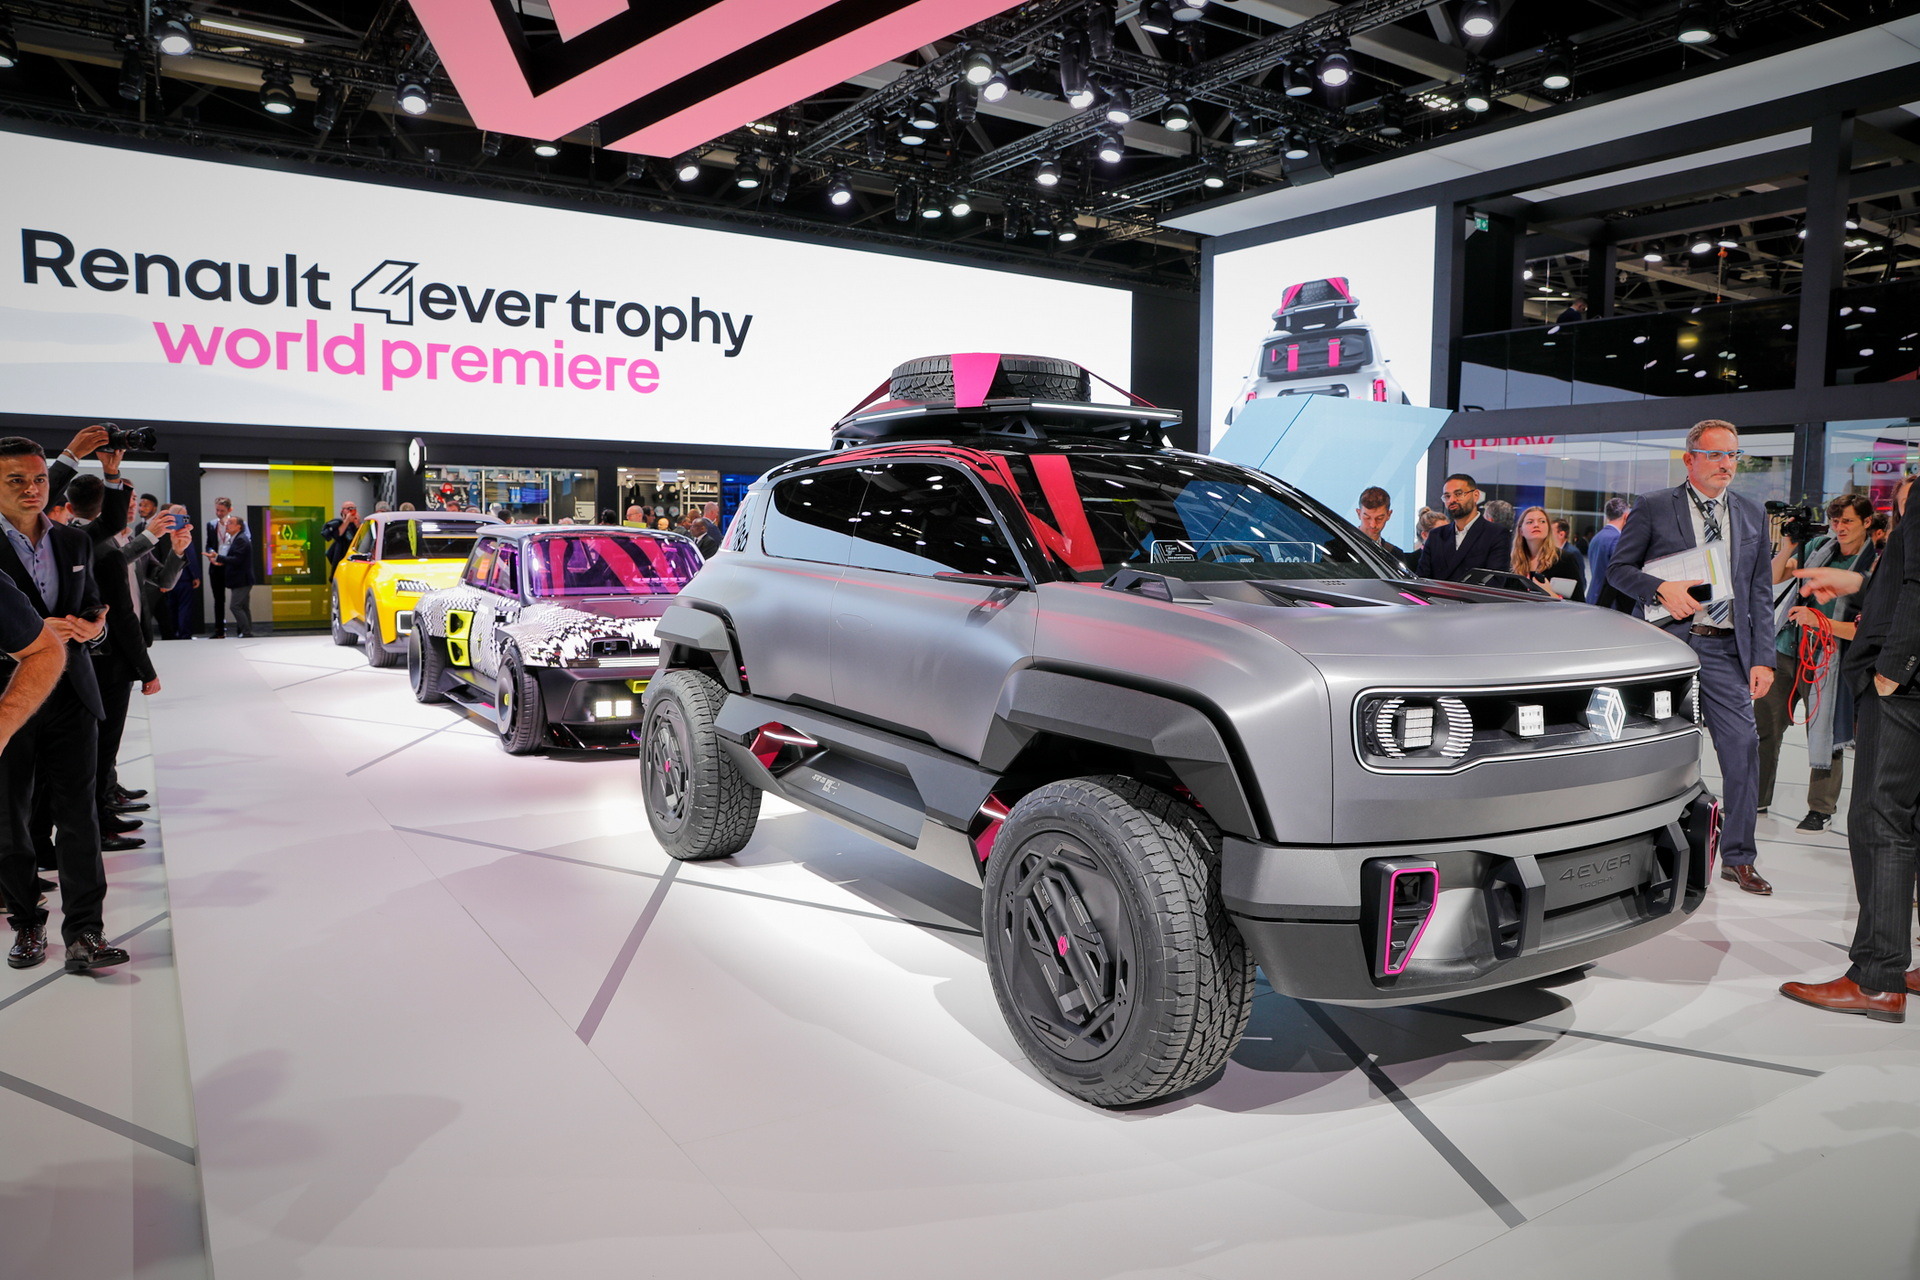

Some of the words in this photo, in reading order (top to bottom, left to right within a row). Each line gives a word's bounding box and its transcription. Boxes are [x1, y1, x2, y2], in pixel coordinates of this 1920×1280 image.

[22, 229, 332, 311] Renault
[351, 260, 558, 329] 4ever
[566, 291, 753, 358] trophy
[153, 319, 366, 376] world
[382, 339, 660, 394] premiere
[1559, 853, 1632, 881] 4EVER
[1578, 876, 1615, 889] TROPHY
